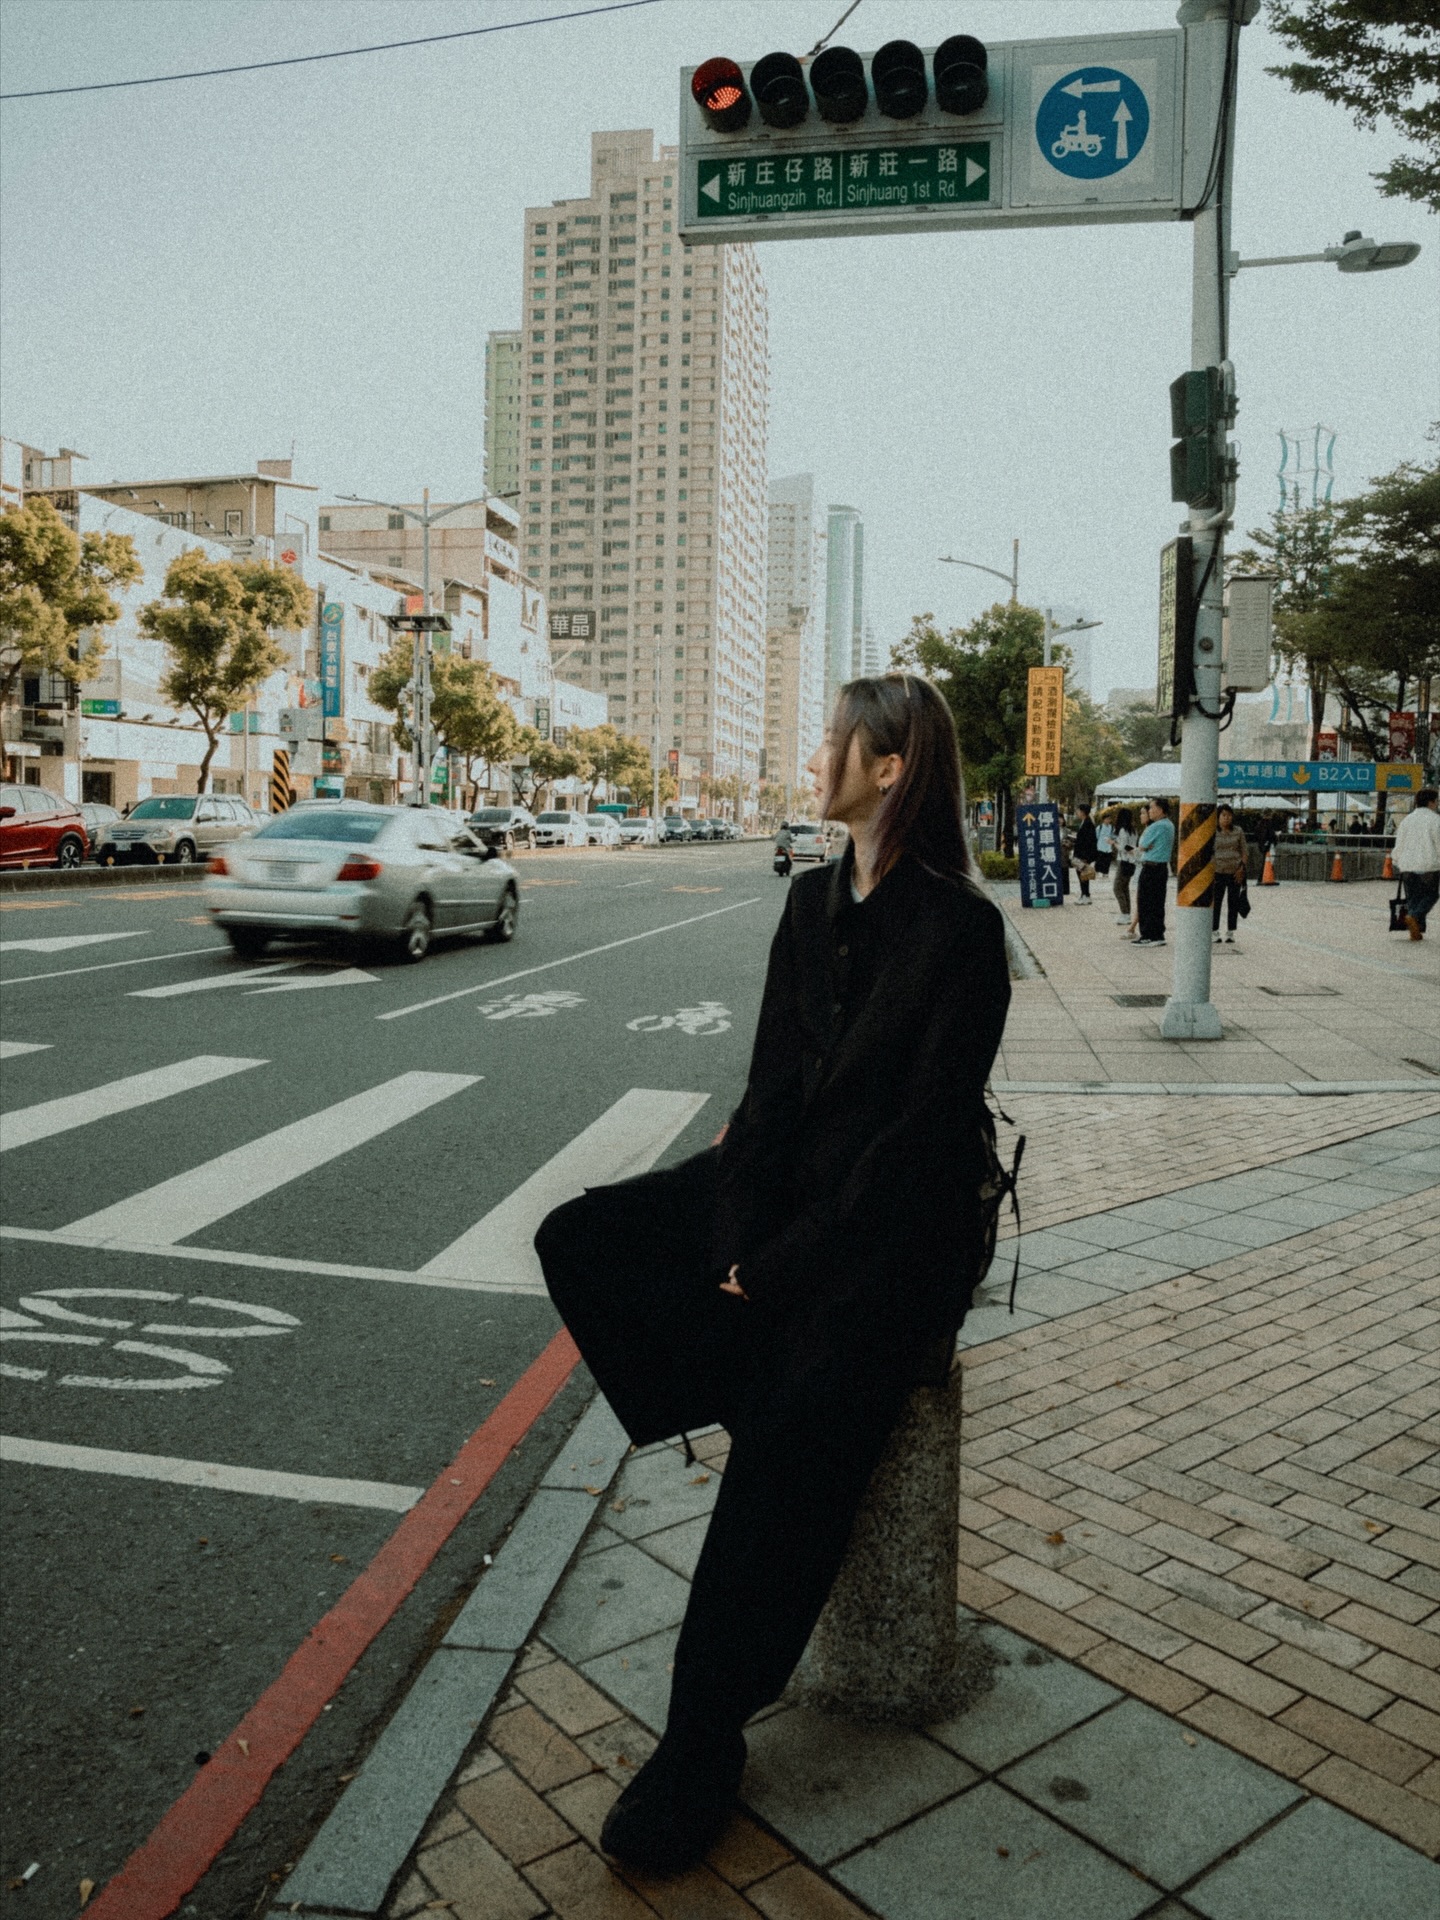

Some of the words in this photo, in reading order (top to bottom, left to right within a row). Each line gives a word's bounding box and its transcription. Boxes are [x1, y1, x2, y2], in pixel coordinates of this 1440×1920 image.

[727, 156, 833, 187] 新庄仔路
[849, 148, 958, 178] 新莊一路
[727, 190, 806, 213] Sinjhuangzih
[816, 187, 837, 206] Rd.
[847, 183, 908, 206] Sinjhuang
[912, 181, 931, 198] 1st
[938, 179, 959, 197] Rd.
[551, 613, 590, 637] 華晶
[1030, 686, 1043, 774] 請配合勤務執行
[1233, 764, 1287, 778] 汽車通道
[1318, 766, 1371, 781] B2入口
[1038, 811, 1058, 898] 停車場入口
